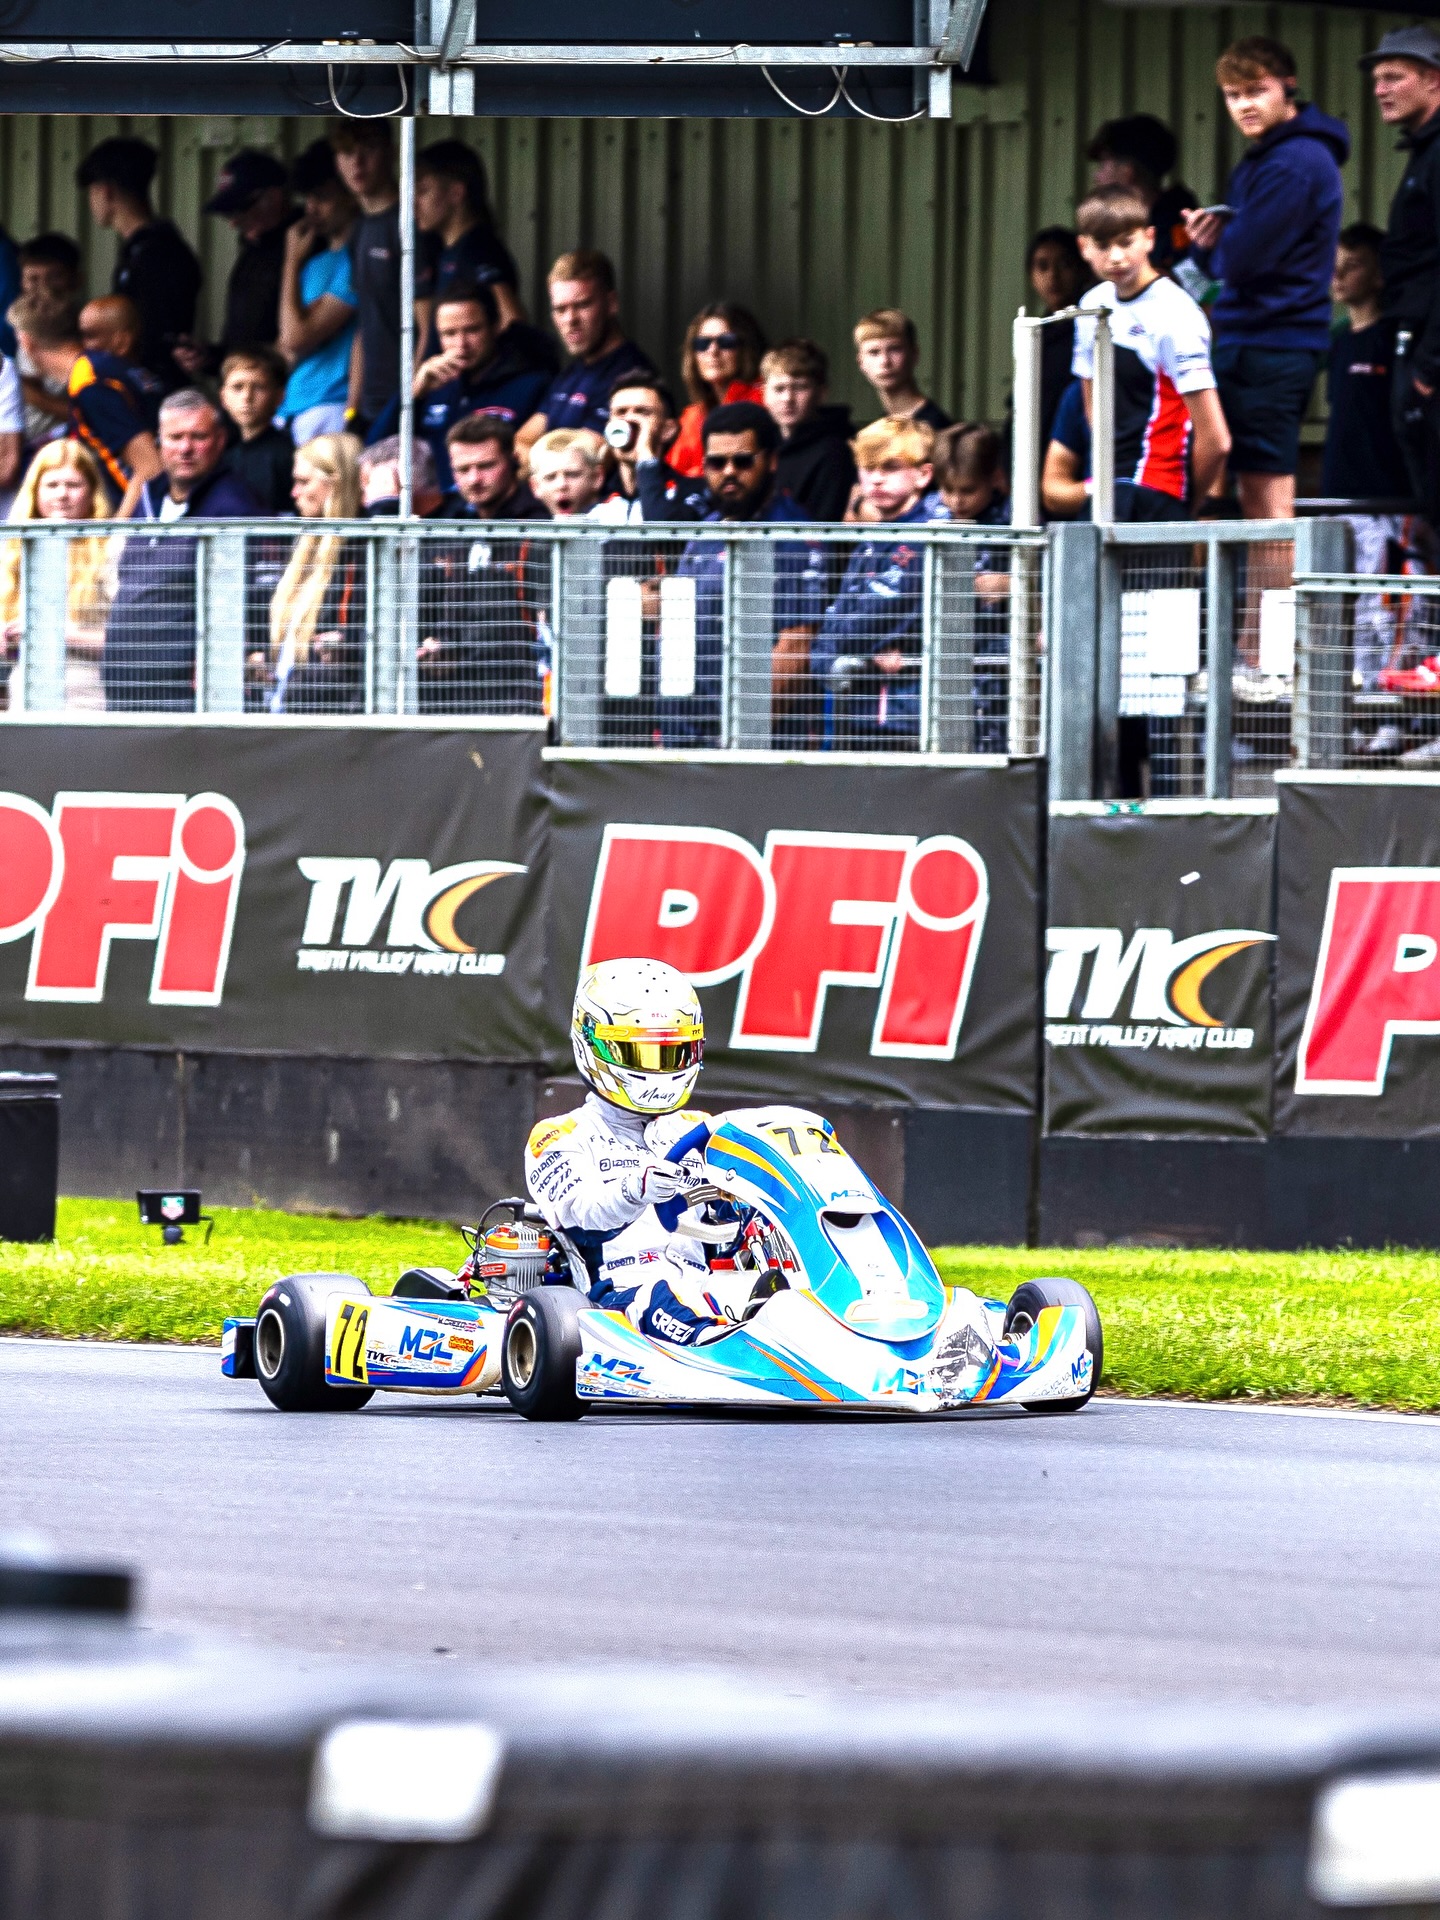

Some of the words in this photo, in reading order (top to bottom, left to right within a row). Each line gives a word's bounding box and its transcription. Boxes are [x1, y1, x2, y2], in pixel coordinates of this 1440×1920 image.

[579, 823, 989, 1060] PFi
[458, 953, 506, 975] CLUB
[1206, 1028, 1254, 1049] CLUB
[772, 1125, 839, 1156] 72
[335, 1304, 368, 1380] 72
